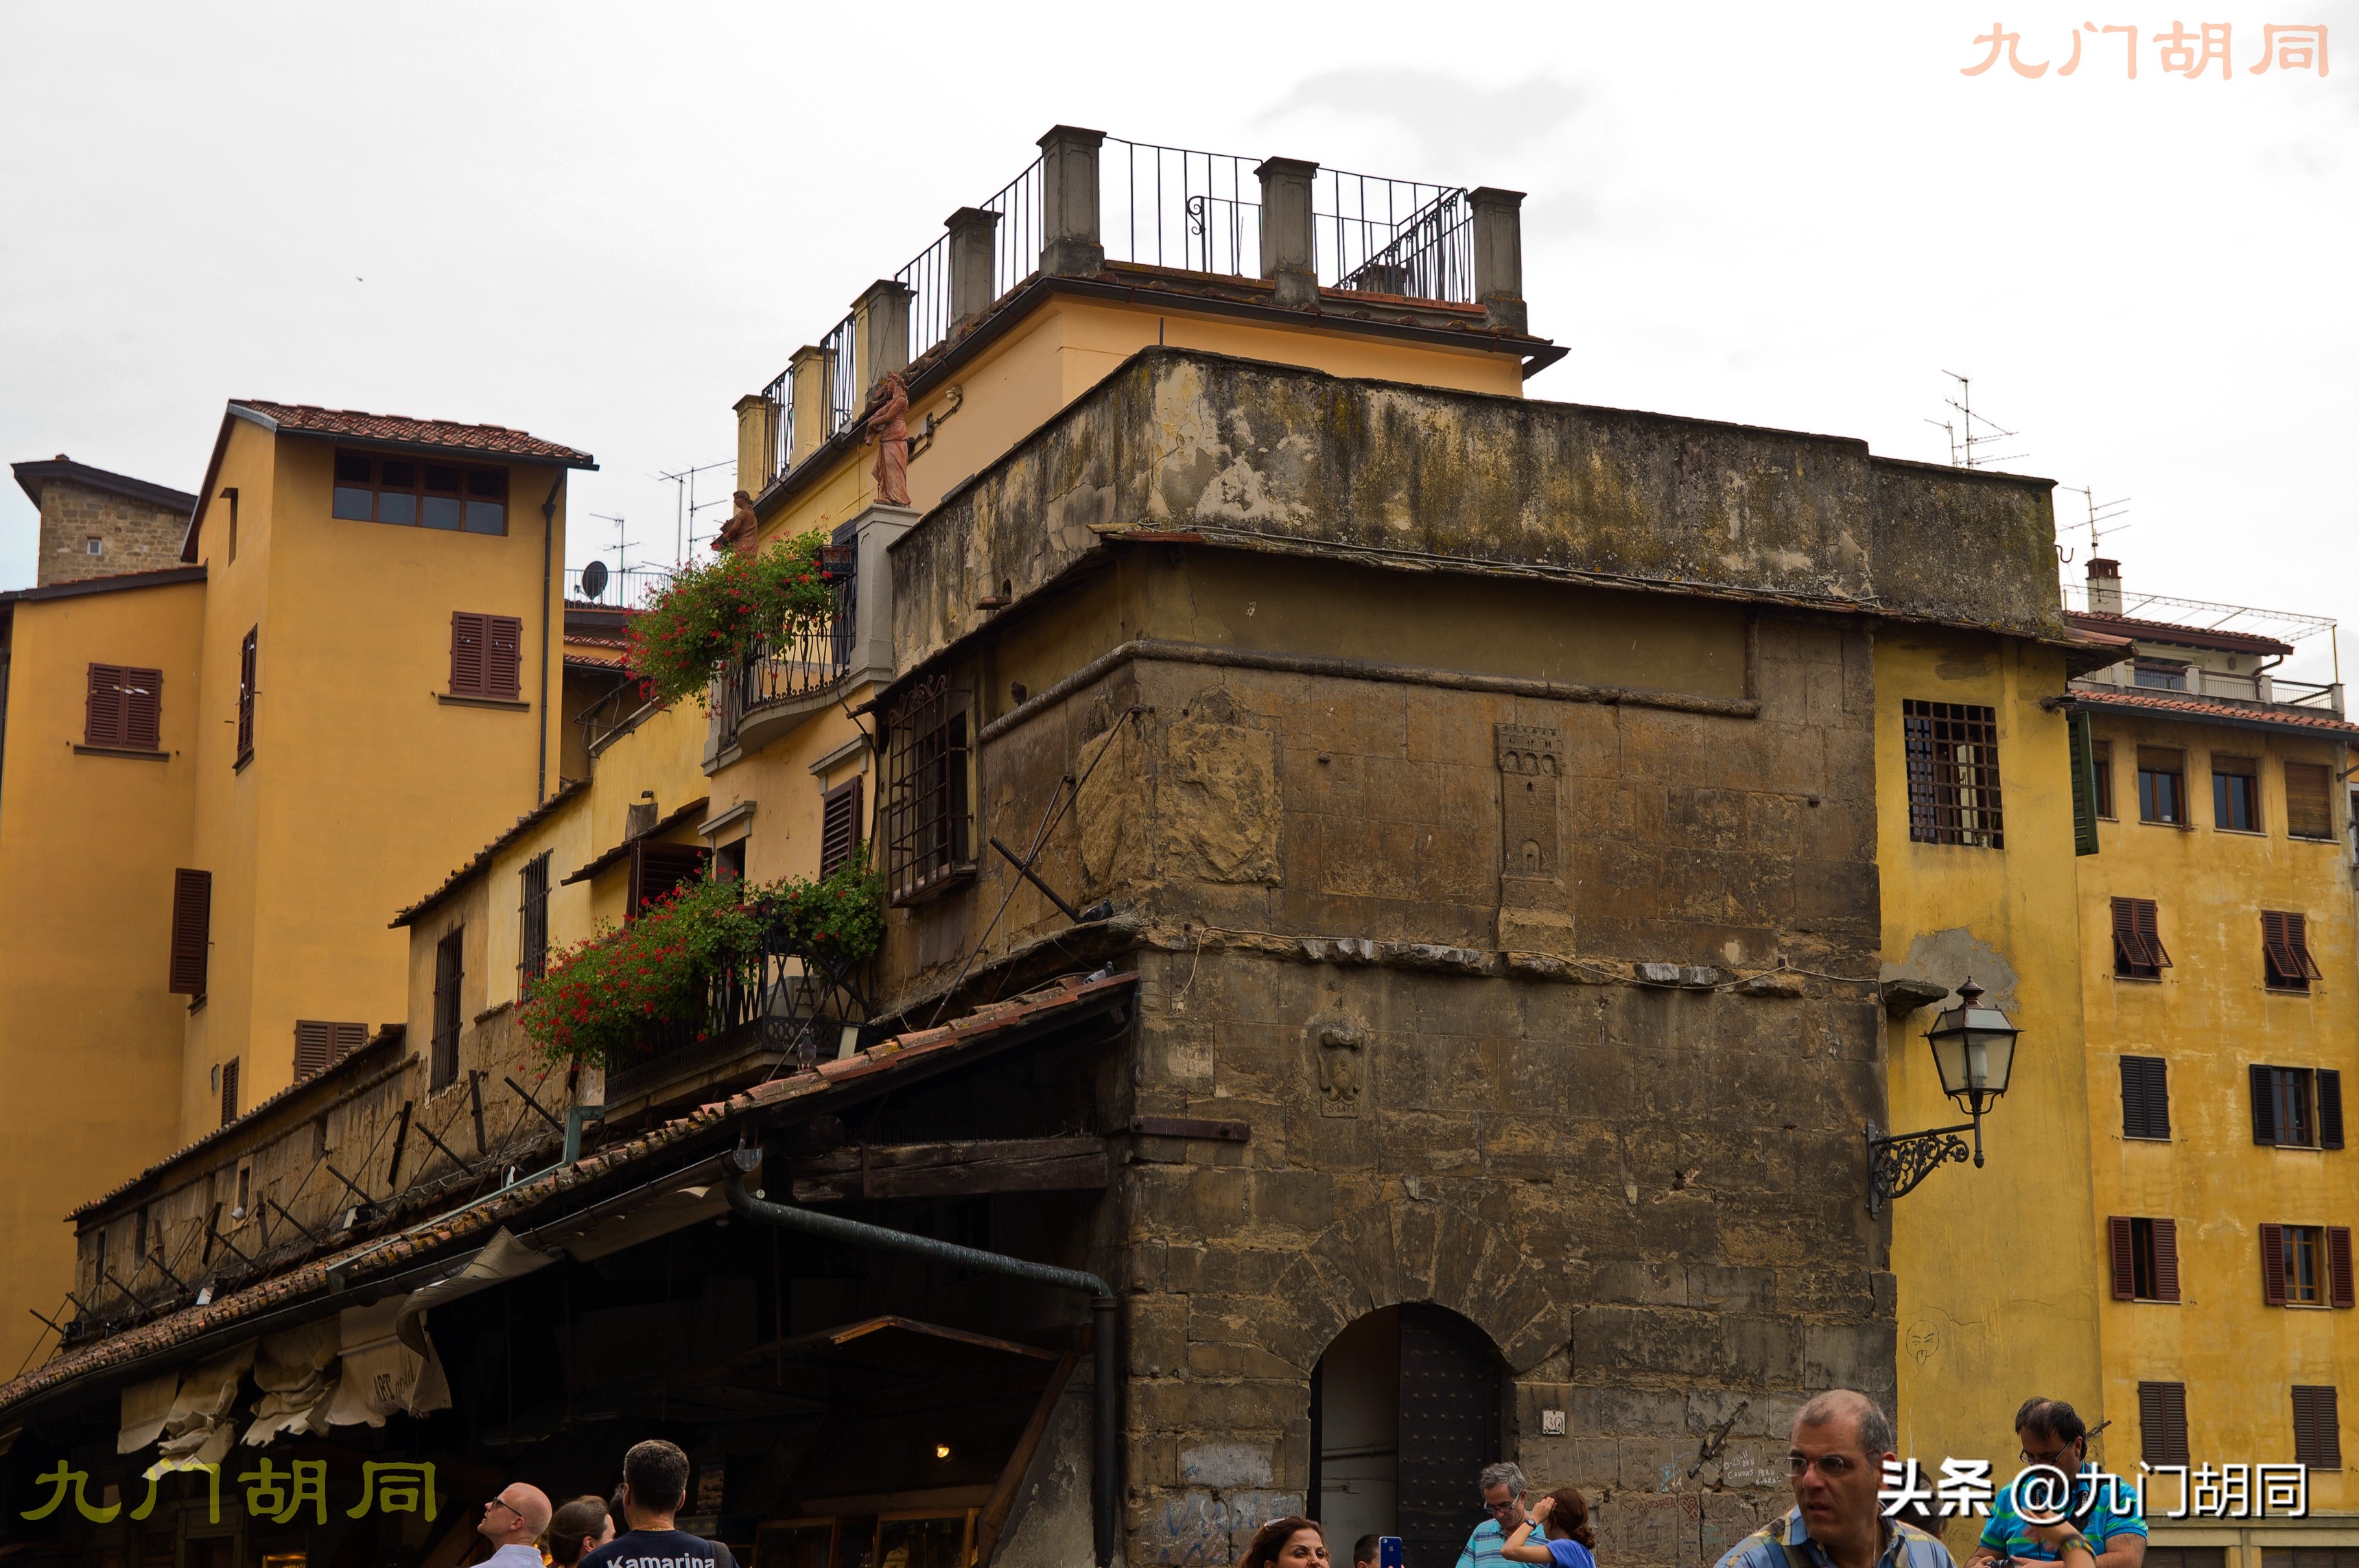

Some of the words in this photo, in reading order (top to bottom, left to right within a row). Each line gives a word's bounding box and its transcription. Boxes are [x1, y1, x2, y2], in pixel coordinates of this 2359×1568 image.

[373, 1373, 396, 1403] ART
[1545, 1416, 1563, 1429] 30
[607, 1552, 715, 1568] Kamarina
